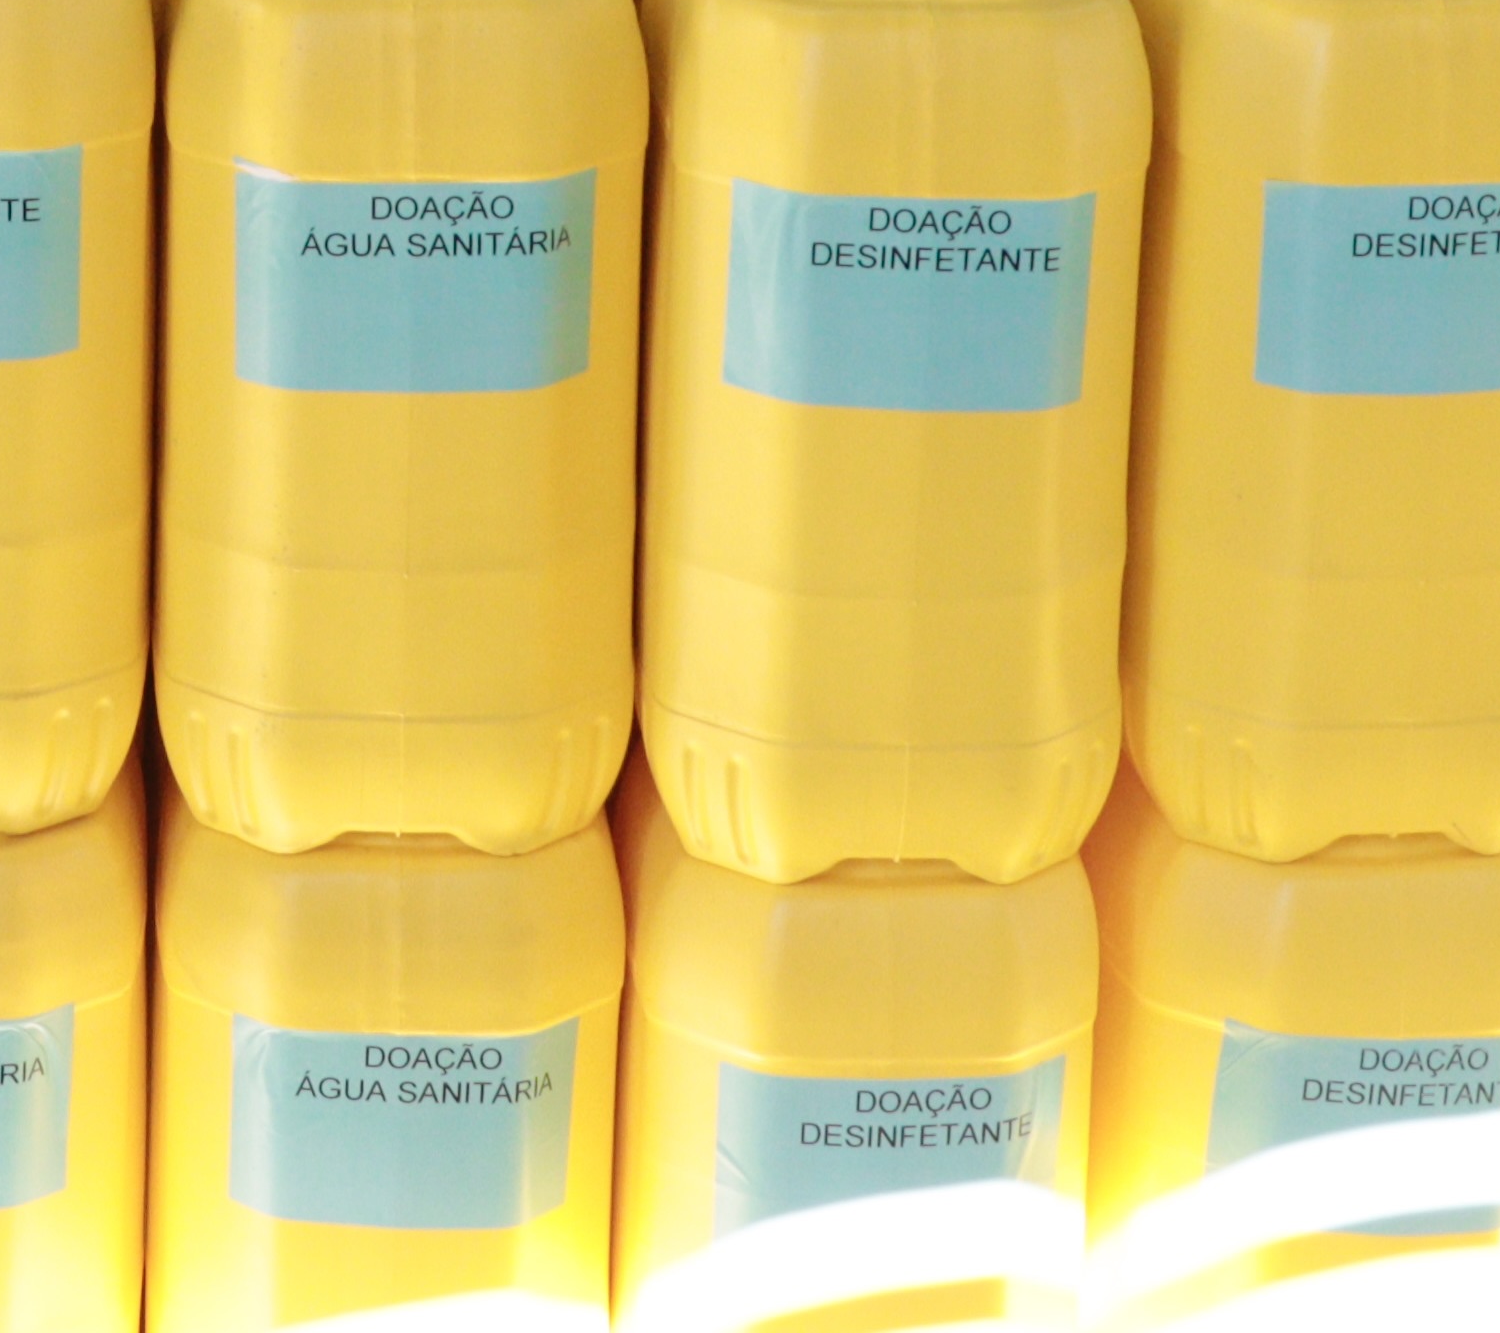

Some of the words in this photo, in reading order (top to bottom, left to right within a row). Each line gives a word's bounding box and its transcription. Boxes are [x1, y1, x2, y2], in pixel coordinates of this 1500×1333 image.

[371, 191, 514, 226] DOAÇÃO
[869, 206, 1012, 241] DOAÇÃO
[301, 224, 395, 259] ÁGUA
[406, 226, 571, 259] SANITÁRIA
[810, 241, 1061, 274] DESINFETANTE
[364, 1042, 502, 1076] DOAÇÃO
[1359, 1044, 1489, 1077] DOAÇÃO
[295, 1070, 386, 1102] ÁGUA
[398, 1073, 552, 1104] SANITÁRIA
[855, 1085, 992, 1118] DOAÇÃO
[800, 1114, 1031, 1149] DESINFETANTE
